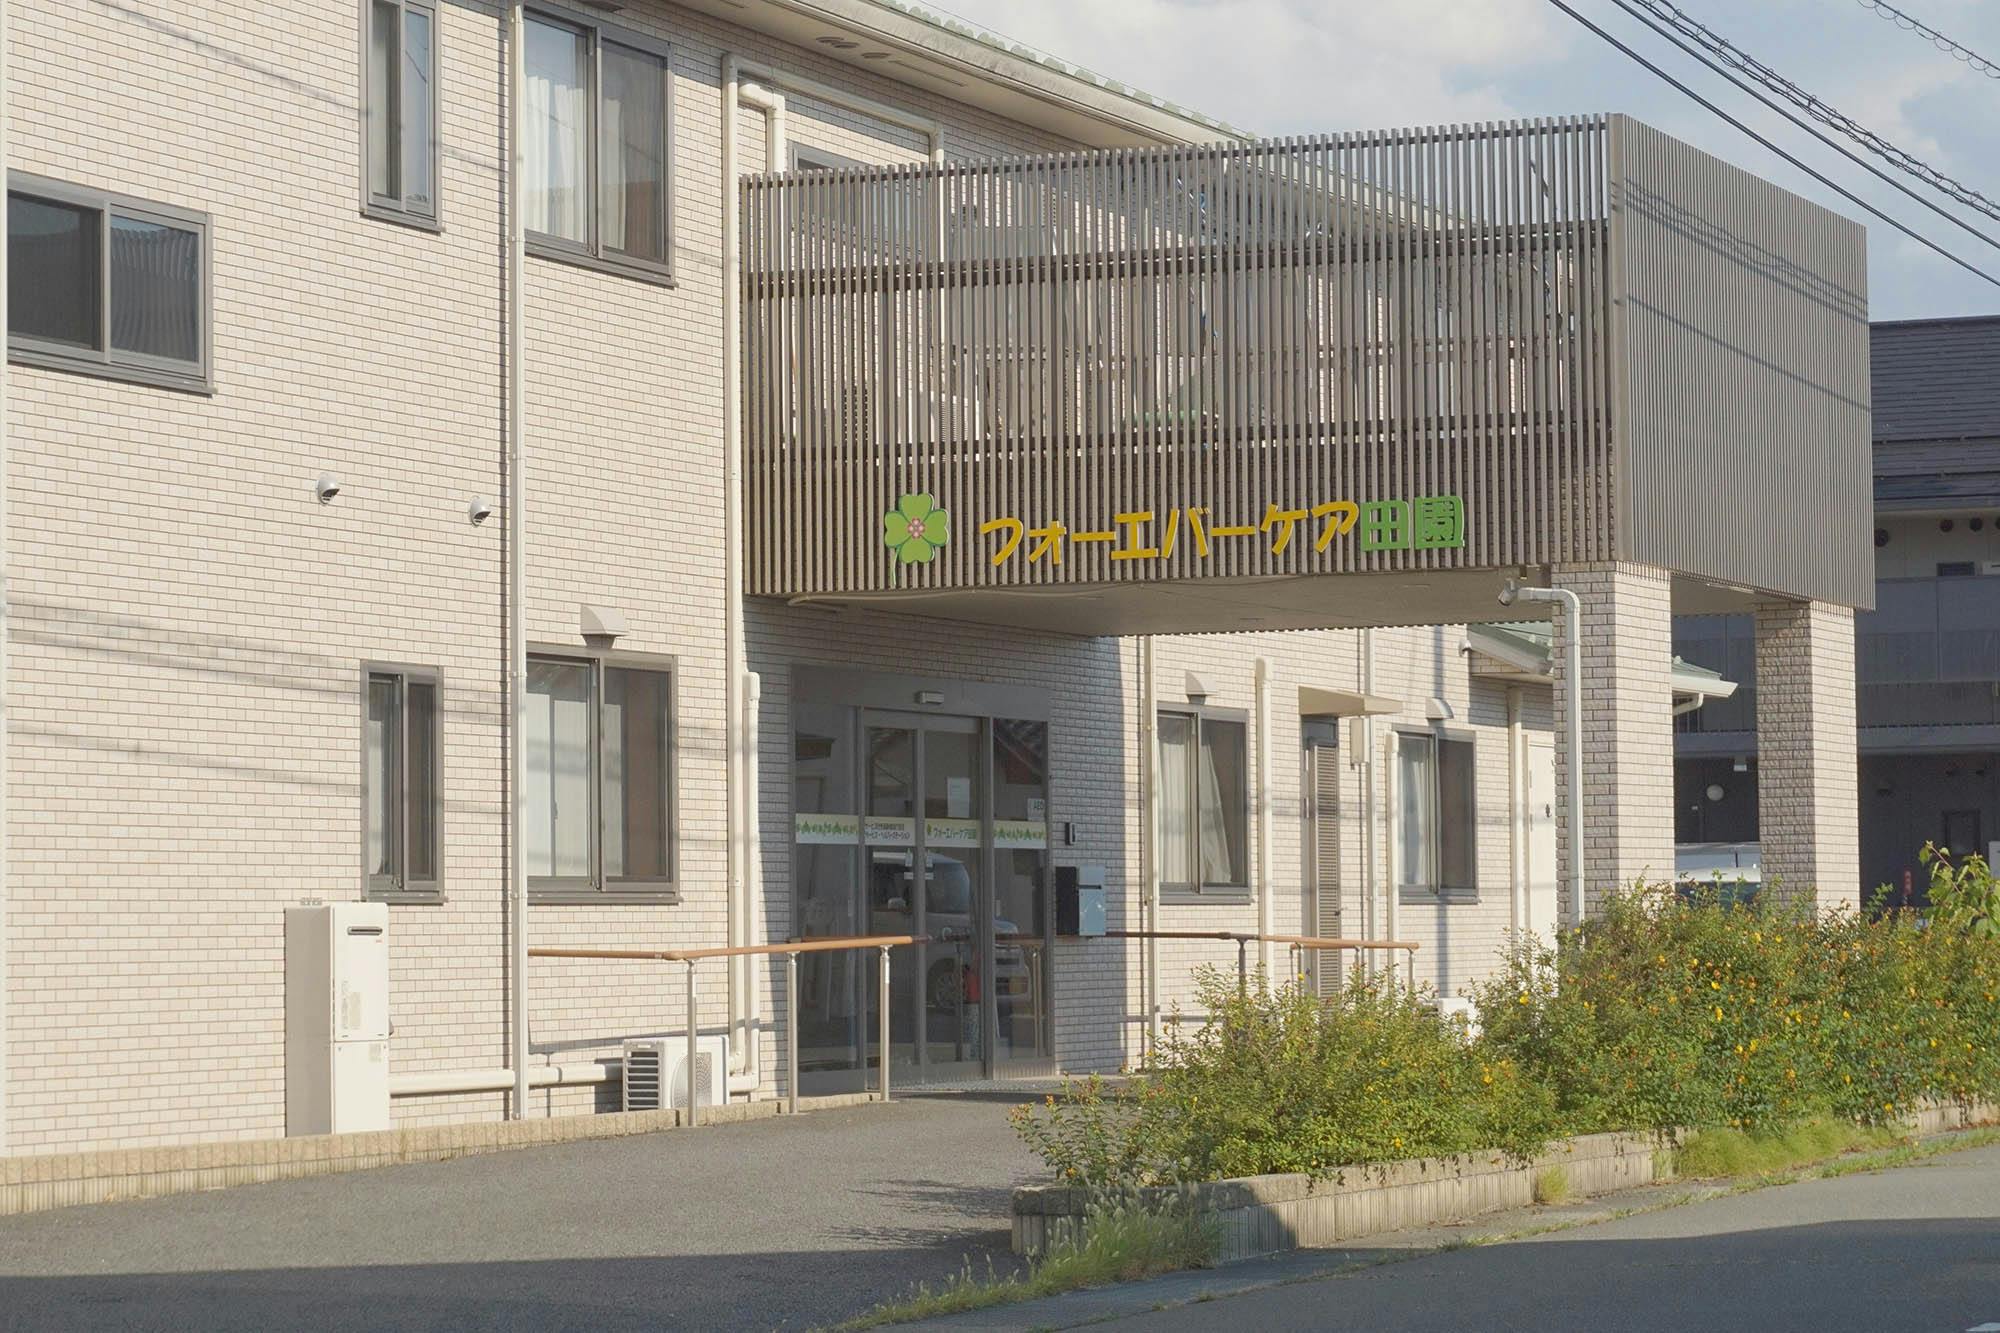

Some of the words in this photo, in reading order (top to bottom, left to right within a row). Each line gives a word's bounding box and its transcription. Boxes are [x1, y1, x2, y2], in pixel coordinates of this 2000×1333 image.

[979, 495, 1466, 566] フォーエバーケア田園
